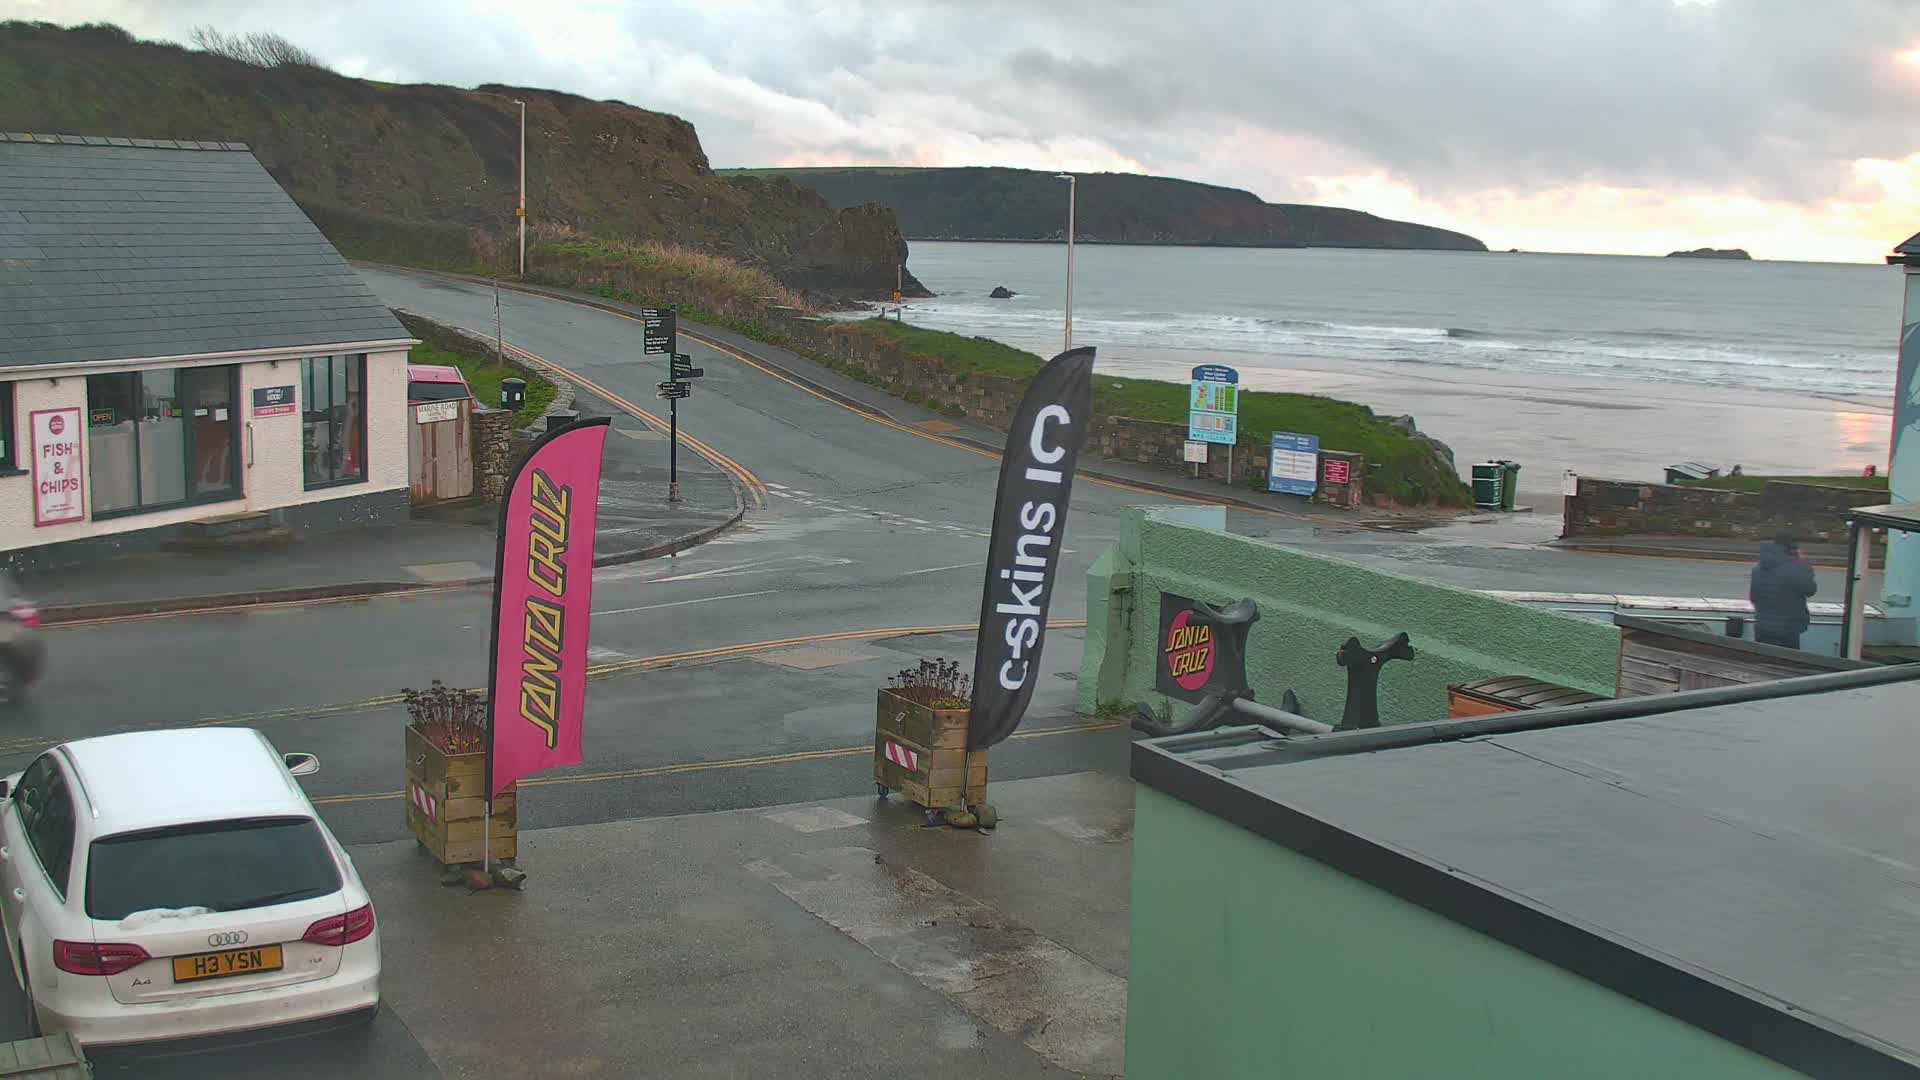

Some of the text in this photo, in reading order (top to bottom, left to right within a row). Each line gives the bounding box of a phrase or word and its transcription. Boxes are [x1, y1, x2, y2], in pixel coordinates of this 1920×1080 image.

[93, 412, 113, 421] OPEN
[43, 442, 73, 458] FISH
[54, 461, 65, 474] &
[40, 478, 79, 495] CHIPS
[996, 500, 1056, 691] c-skins
[520, 468, 571, 748] SANTA CRUZ
[1165, 625, 1210, 653] SANTA
[1172, 648, 1209, 677] CRUZ
[194, 950, 263, 975] H3 YSN
[131, 978, 152, 988] A4
